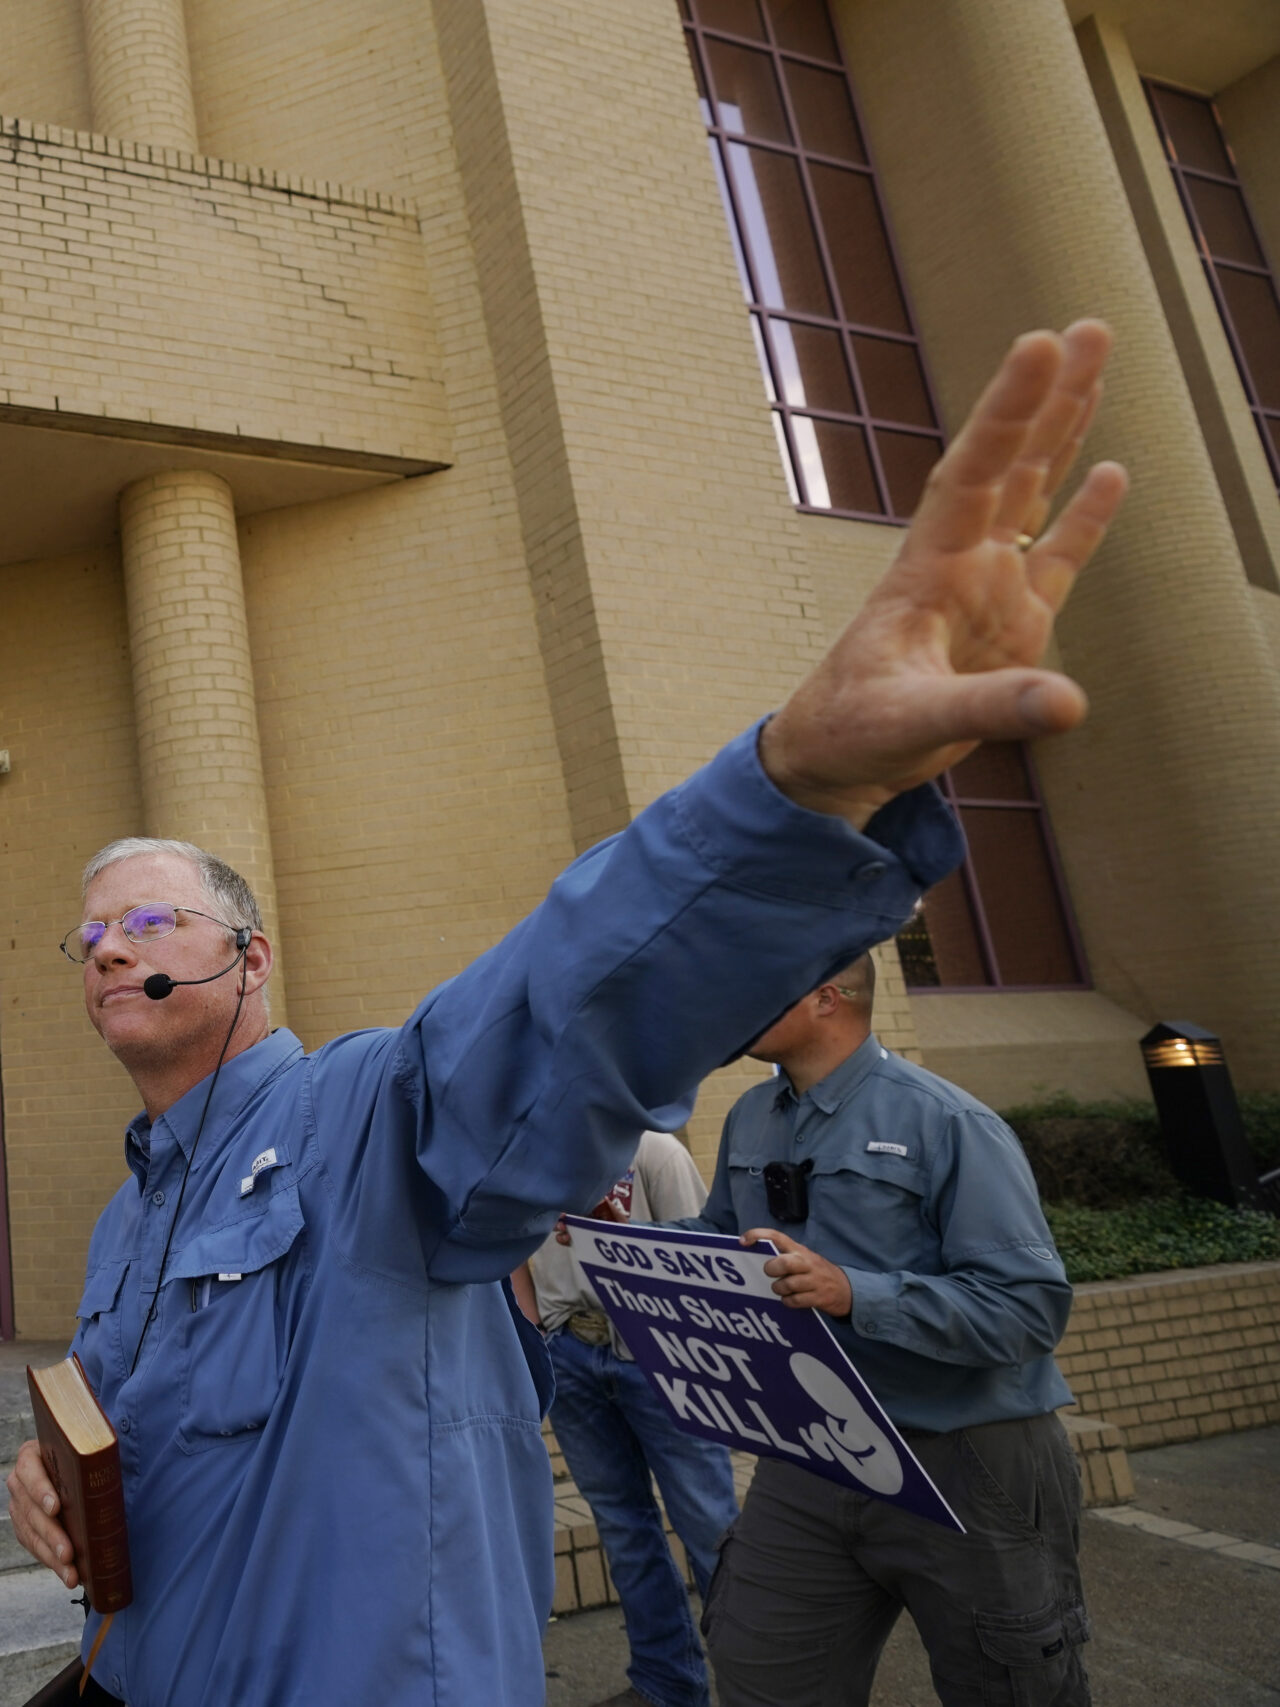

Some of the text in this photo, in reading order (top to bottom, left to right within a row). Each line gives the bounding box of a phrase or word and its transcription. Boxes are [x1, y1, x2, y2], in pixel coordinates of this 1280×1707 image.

[594, 1237, 747, 1287] GOD SAYS
[595, 1275, 794, 1348] Thou Shalt
[648, 1326, 764, 1392] NOT
[652, 1371, 811, 1460] KILL
